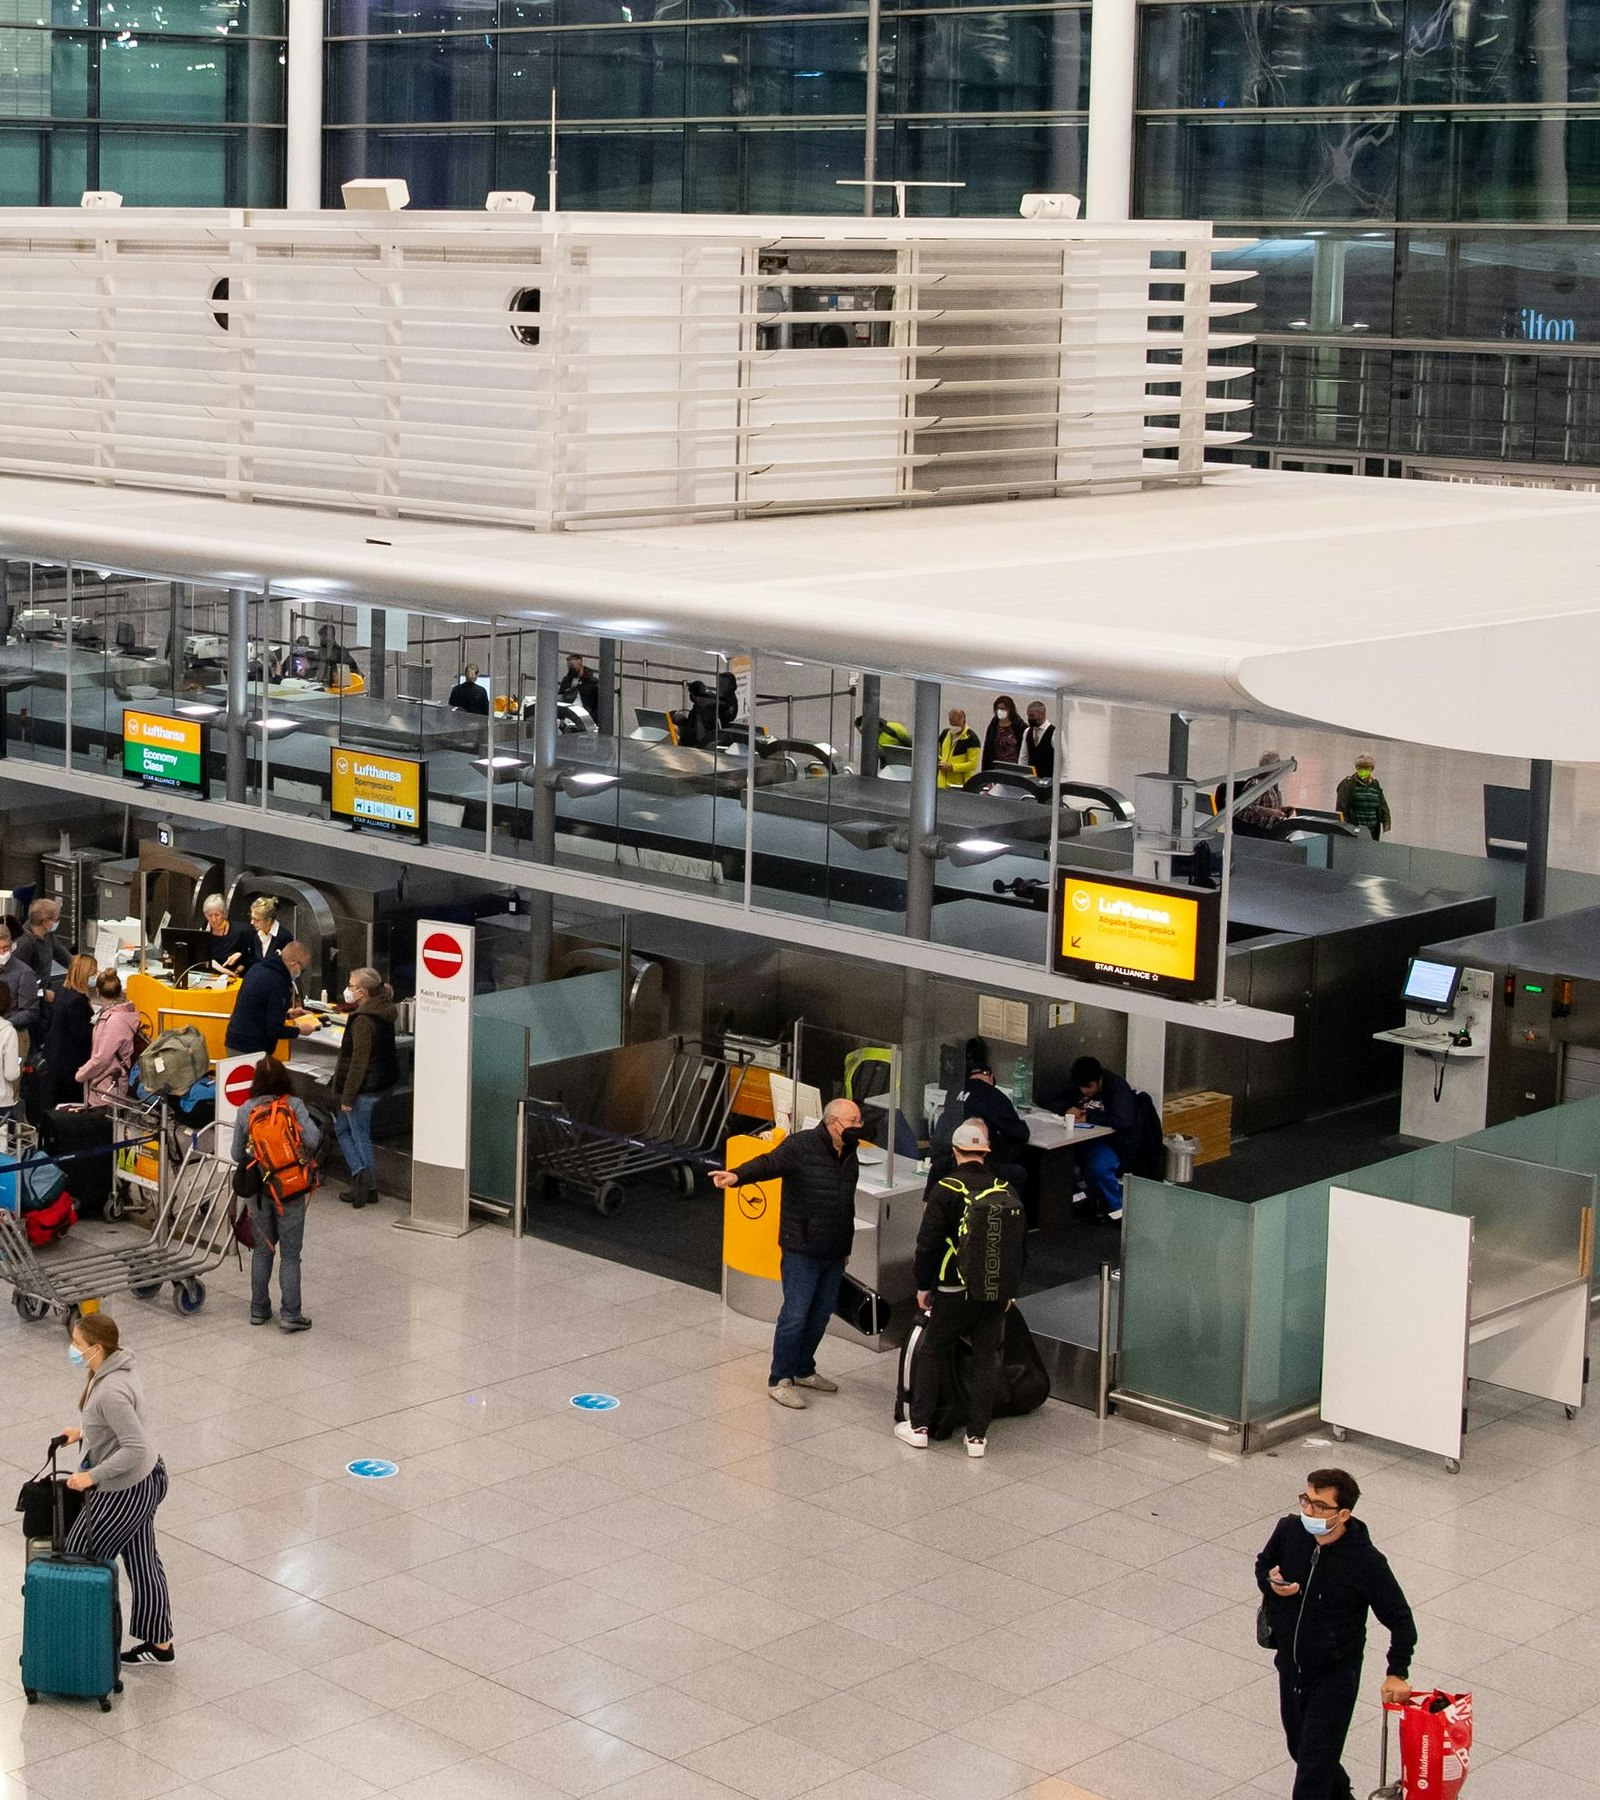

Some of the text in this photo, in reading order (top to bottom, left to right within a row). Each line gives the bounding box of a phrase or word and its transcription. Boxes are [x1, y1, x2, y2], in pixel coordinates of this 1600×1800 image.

[1501, 308, 1575, 341] ilton
[142, 723, 186, 743] Lufthansa
[143, 747, 178, 766] Economy
[143, 759, 164, 773] Class
[353, 762, 402, 783] Lufthansa
[353, 816, 391, 830] STAR ALLIANCE
[1098, 897, 1170, 924] Lufthansa
[1099, 915, 1176, 936] Abgabe Sperrgepäck
[1095, 962, 1150, 979] STAR ALLIANCE
[420, 988, 466, 1003] Kein Eingang
[1419, 1734, 1429, 1777] lululemon
